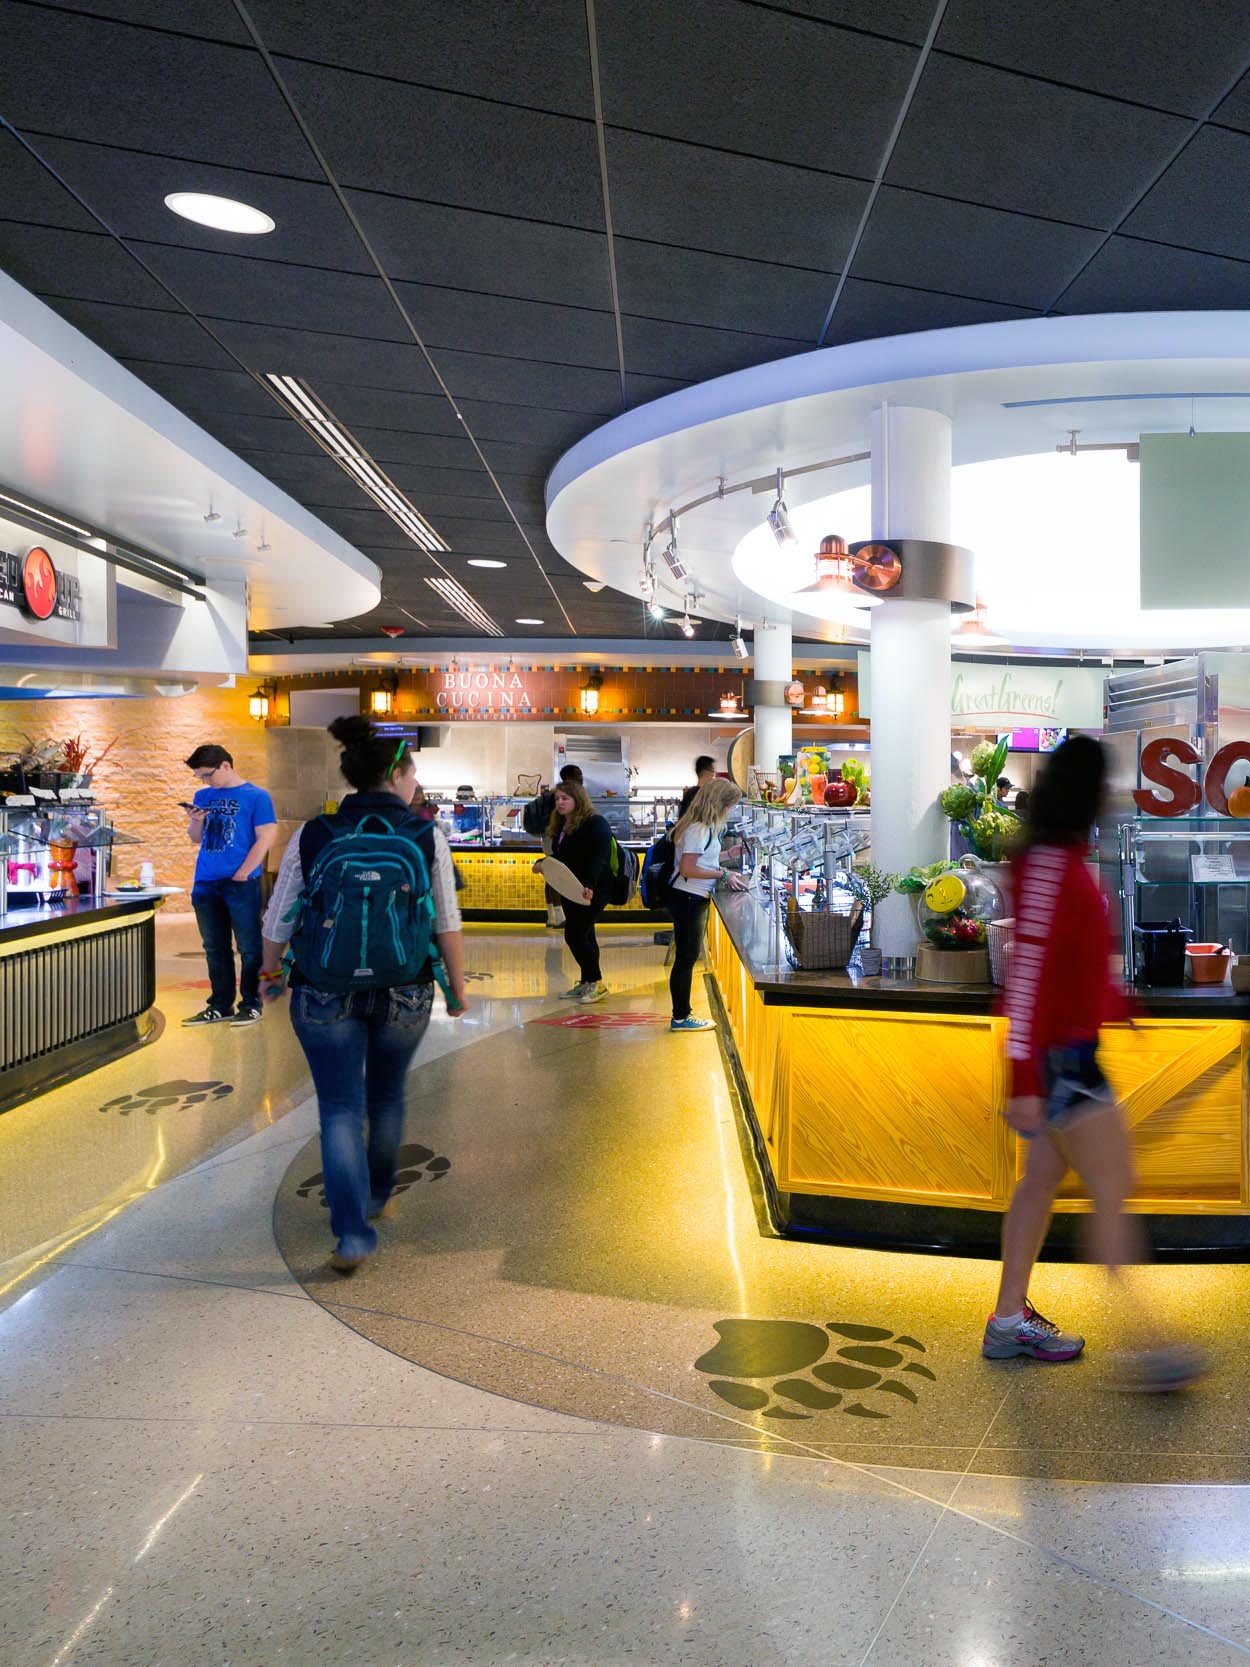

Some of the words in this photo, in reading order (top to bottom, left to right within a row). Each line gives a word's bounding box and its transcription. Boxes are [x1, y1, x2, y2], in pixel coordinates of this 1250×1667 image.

[58, 606, 77, 620] GRILL
[445, 673, 523, 689] BUONA
[436, 691, 532, 707] CUCINA
